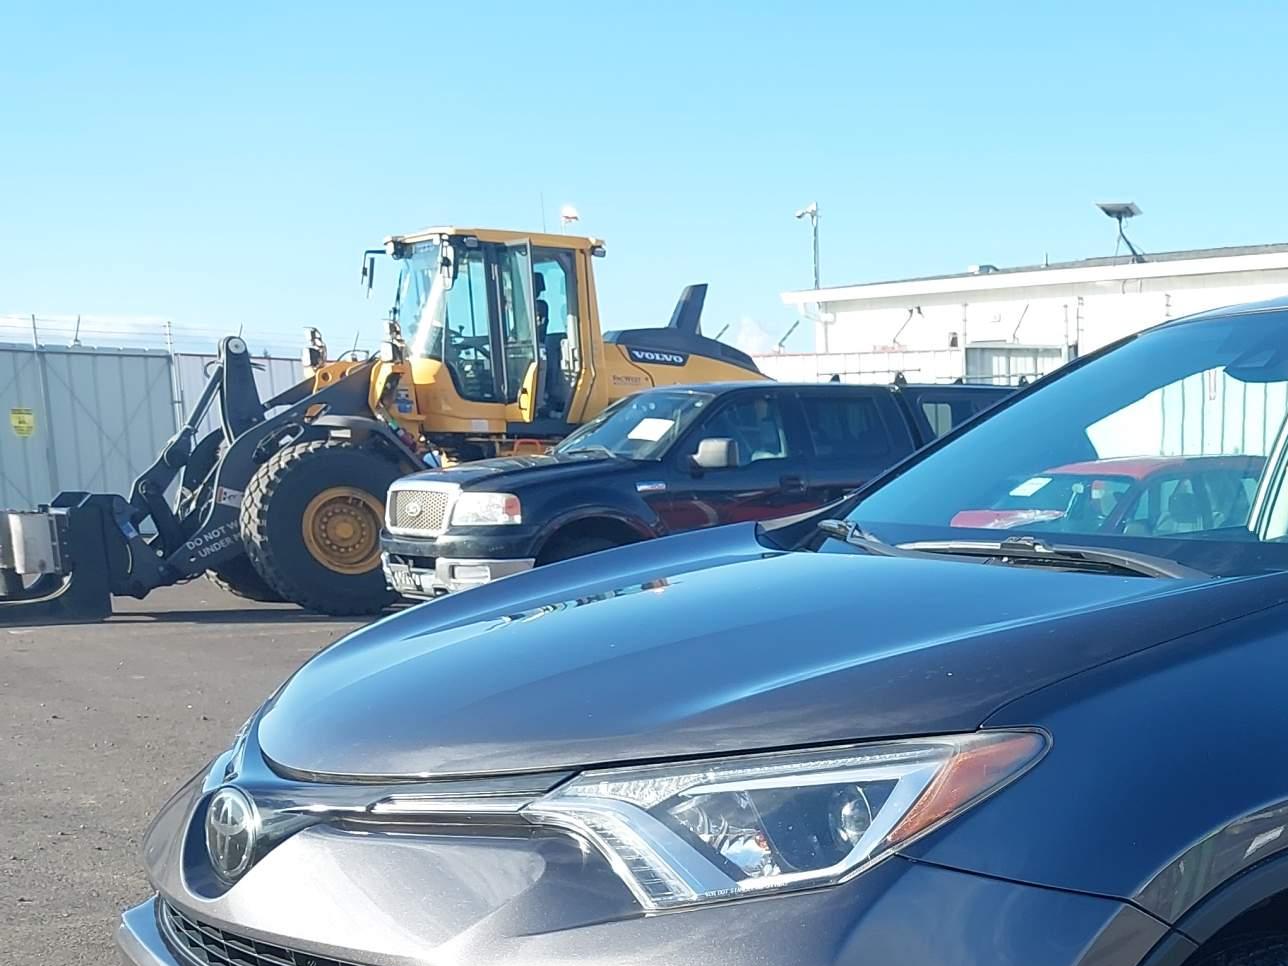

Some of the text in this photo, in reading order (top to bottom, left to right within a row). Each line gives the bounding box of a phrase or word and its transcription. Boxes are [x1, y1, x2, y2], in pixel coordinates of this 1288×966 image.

[632, 350, 684, 363] VOLVO
[186, 538, 203, 550] DO
[203, 526, 226, 541] NOT
[198, 536, 234, 557] UNDER
